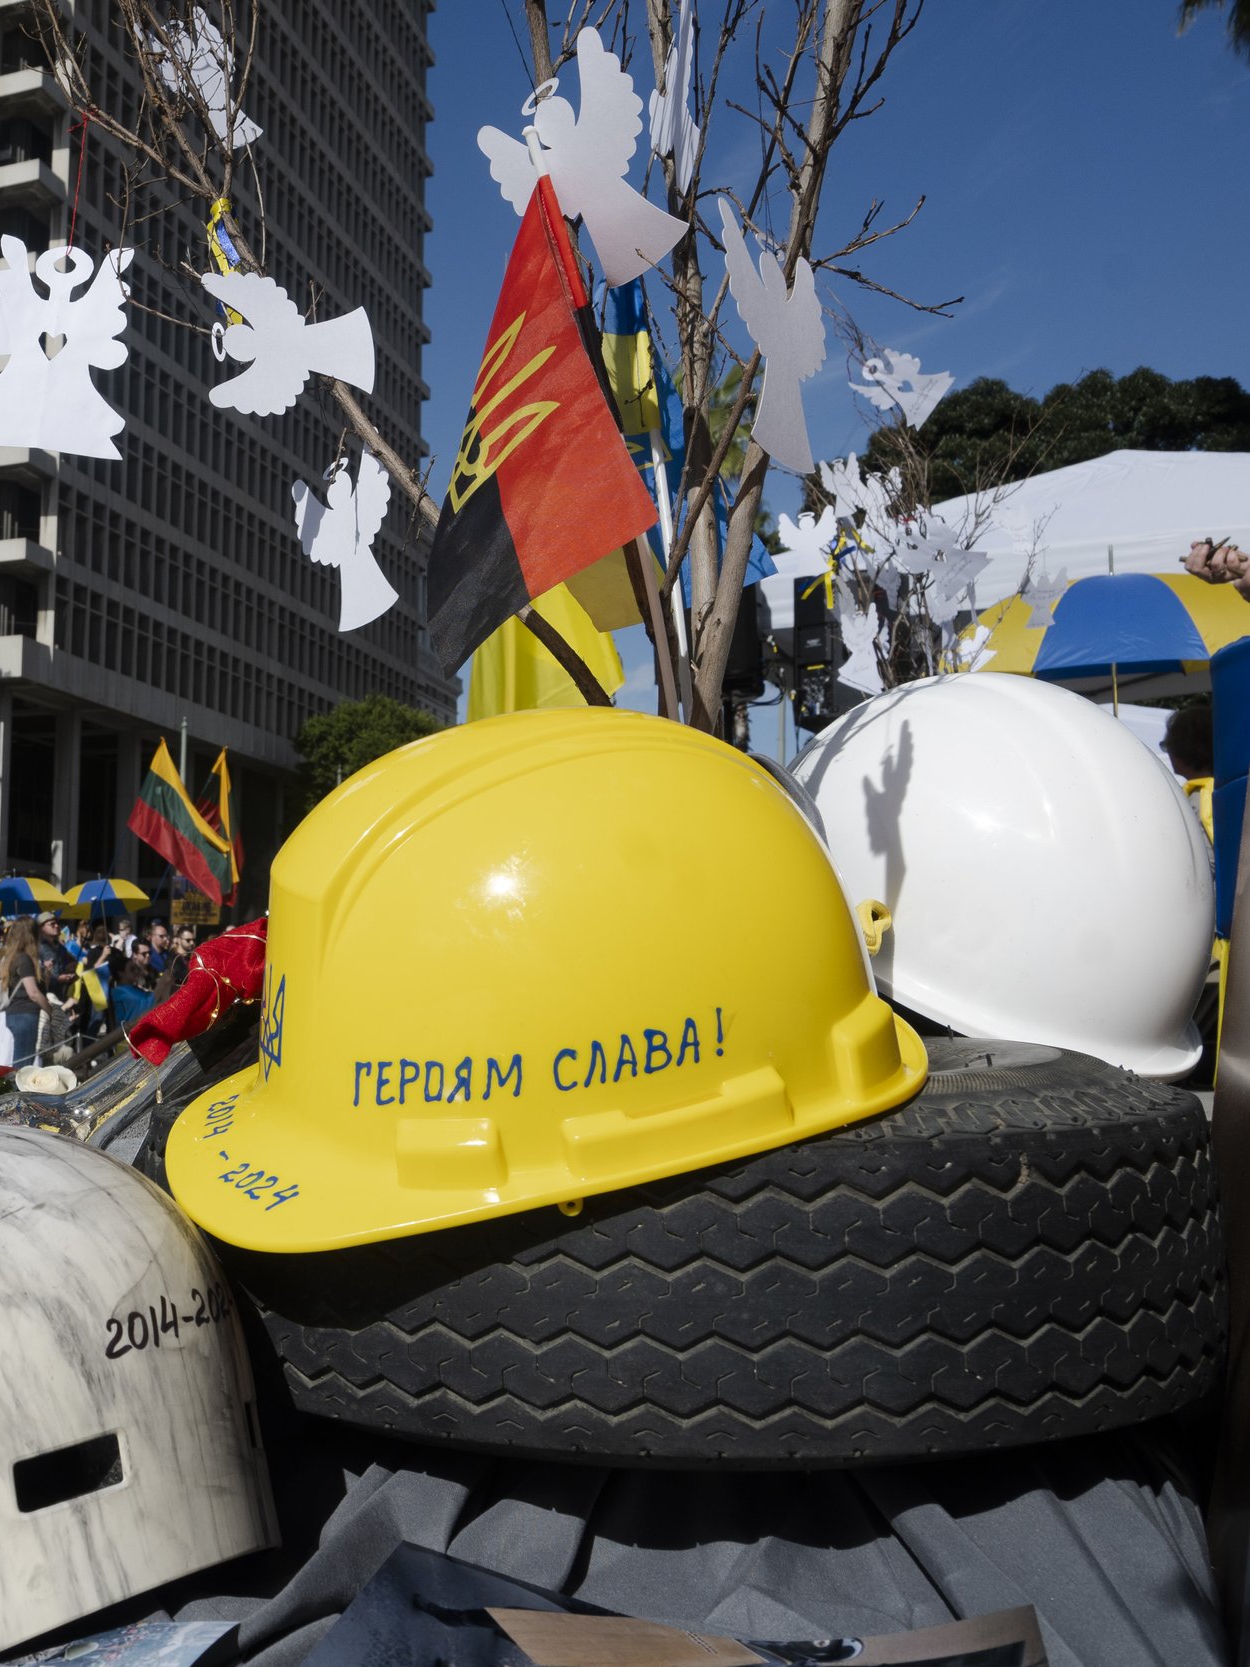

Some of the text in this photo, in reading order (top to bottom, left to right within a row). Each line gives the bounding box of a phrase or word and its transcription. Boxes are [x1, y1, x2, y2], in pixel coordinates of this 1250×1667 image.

[352, 1007, 724, 1107] ГЕРОЯМ СЛАВА!
[203, 1093, 240, 1139] 2014
[105, 1281, 232, 1359] 2014-202
